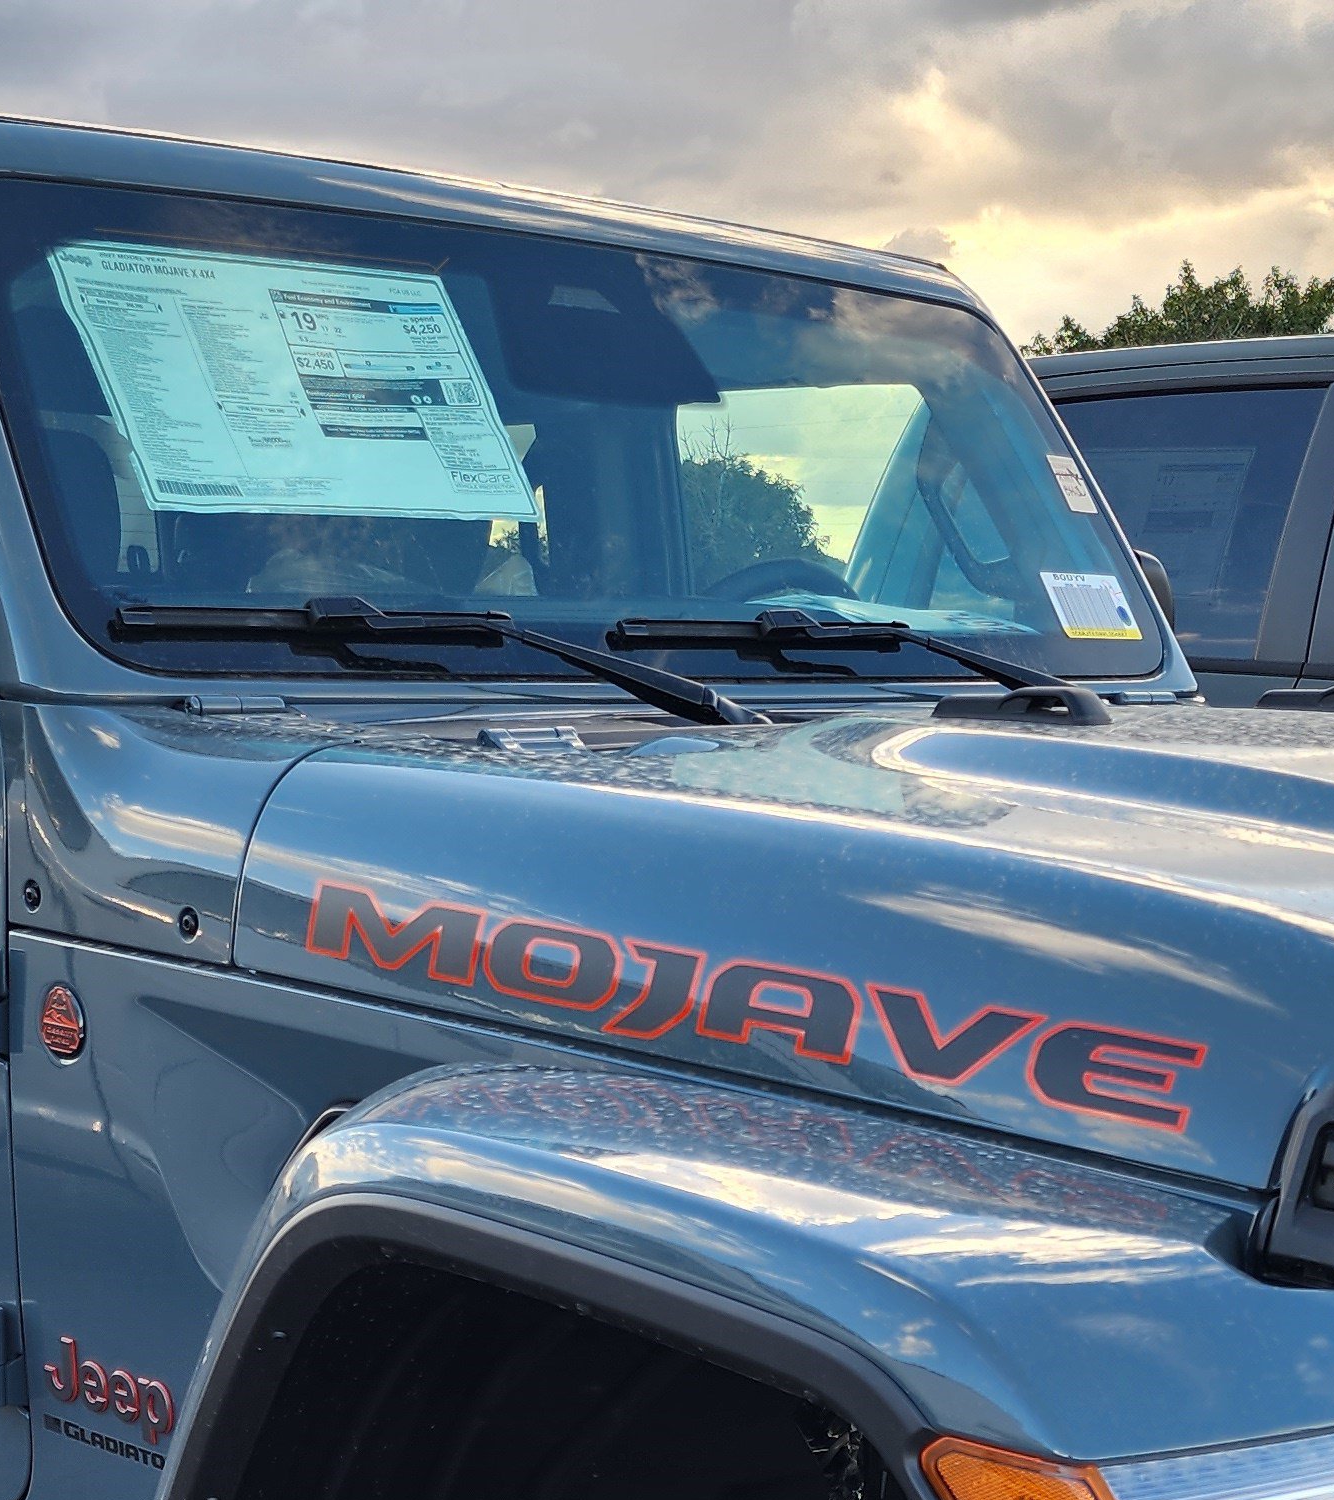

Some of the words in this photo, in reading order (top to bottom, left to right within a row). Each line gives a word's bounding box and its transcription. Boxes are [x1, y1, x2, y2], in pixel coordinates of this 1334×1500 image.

[101, 260, 153, 275] GLADIATOR
[154, 264, 190, 278] MOJAVE
[189, 269, 198, 279] X
[199, 269, 216, 279] 4X4
[290, 311, 317, 331] 19
[402, 324, 442, 335] $4,250
[296, 357, 335, 371] $2,450
[450, 470, 511, 484] FlexCare
[305, 879, 1209, 1134] MOJAVE
[43, 1335, 175, 1446] Jeep
